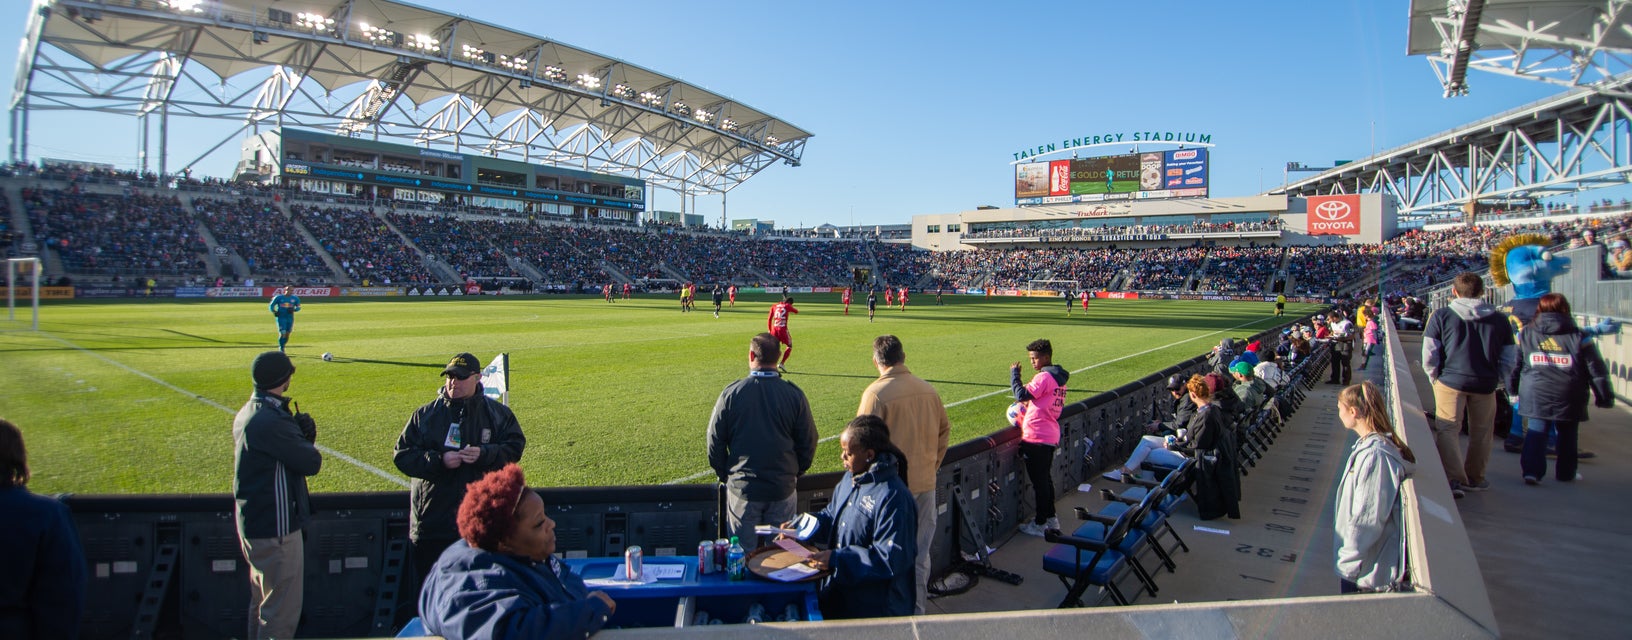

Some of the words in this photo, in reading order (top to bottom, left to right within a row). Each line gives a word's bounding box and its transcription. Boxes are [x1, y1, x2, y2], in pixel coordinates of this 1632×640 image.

[1013, 143, 1055, 161] TALEN
[1063, 133, 1124, 149] ENERGY
[1133, 131, 1212, 144] STADIUM
[1059, 165, 1069, 191] Coca-Cola
[1077, 171, 1099, 179] GOLD
[1312, 221, 1355, 230] TOYOTA
[774, 307, 786, 319] 62
[1533, 355, 1569, 364] BIMBO
